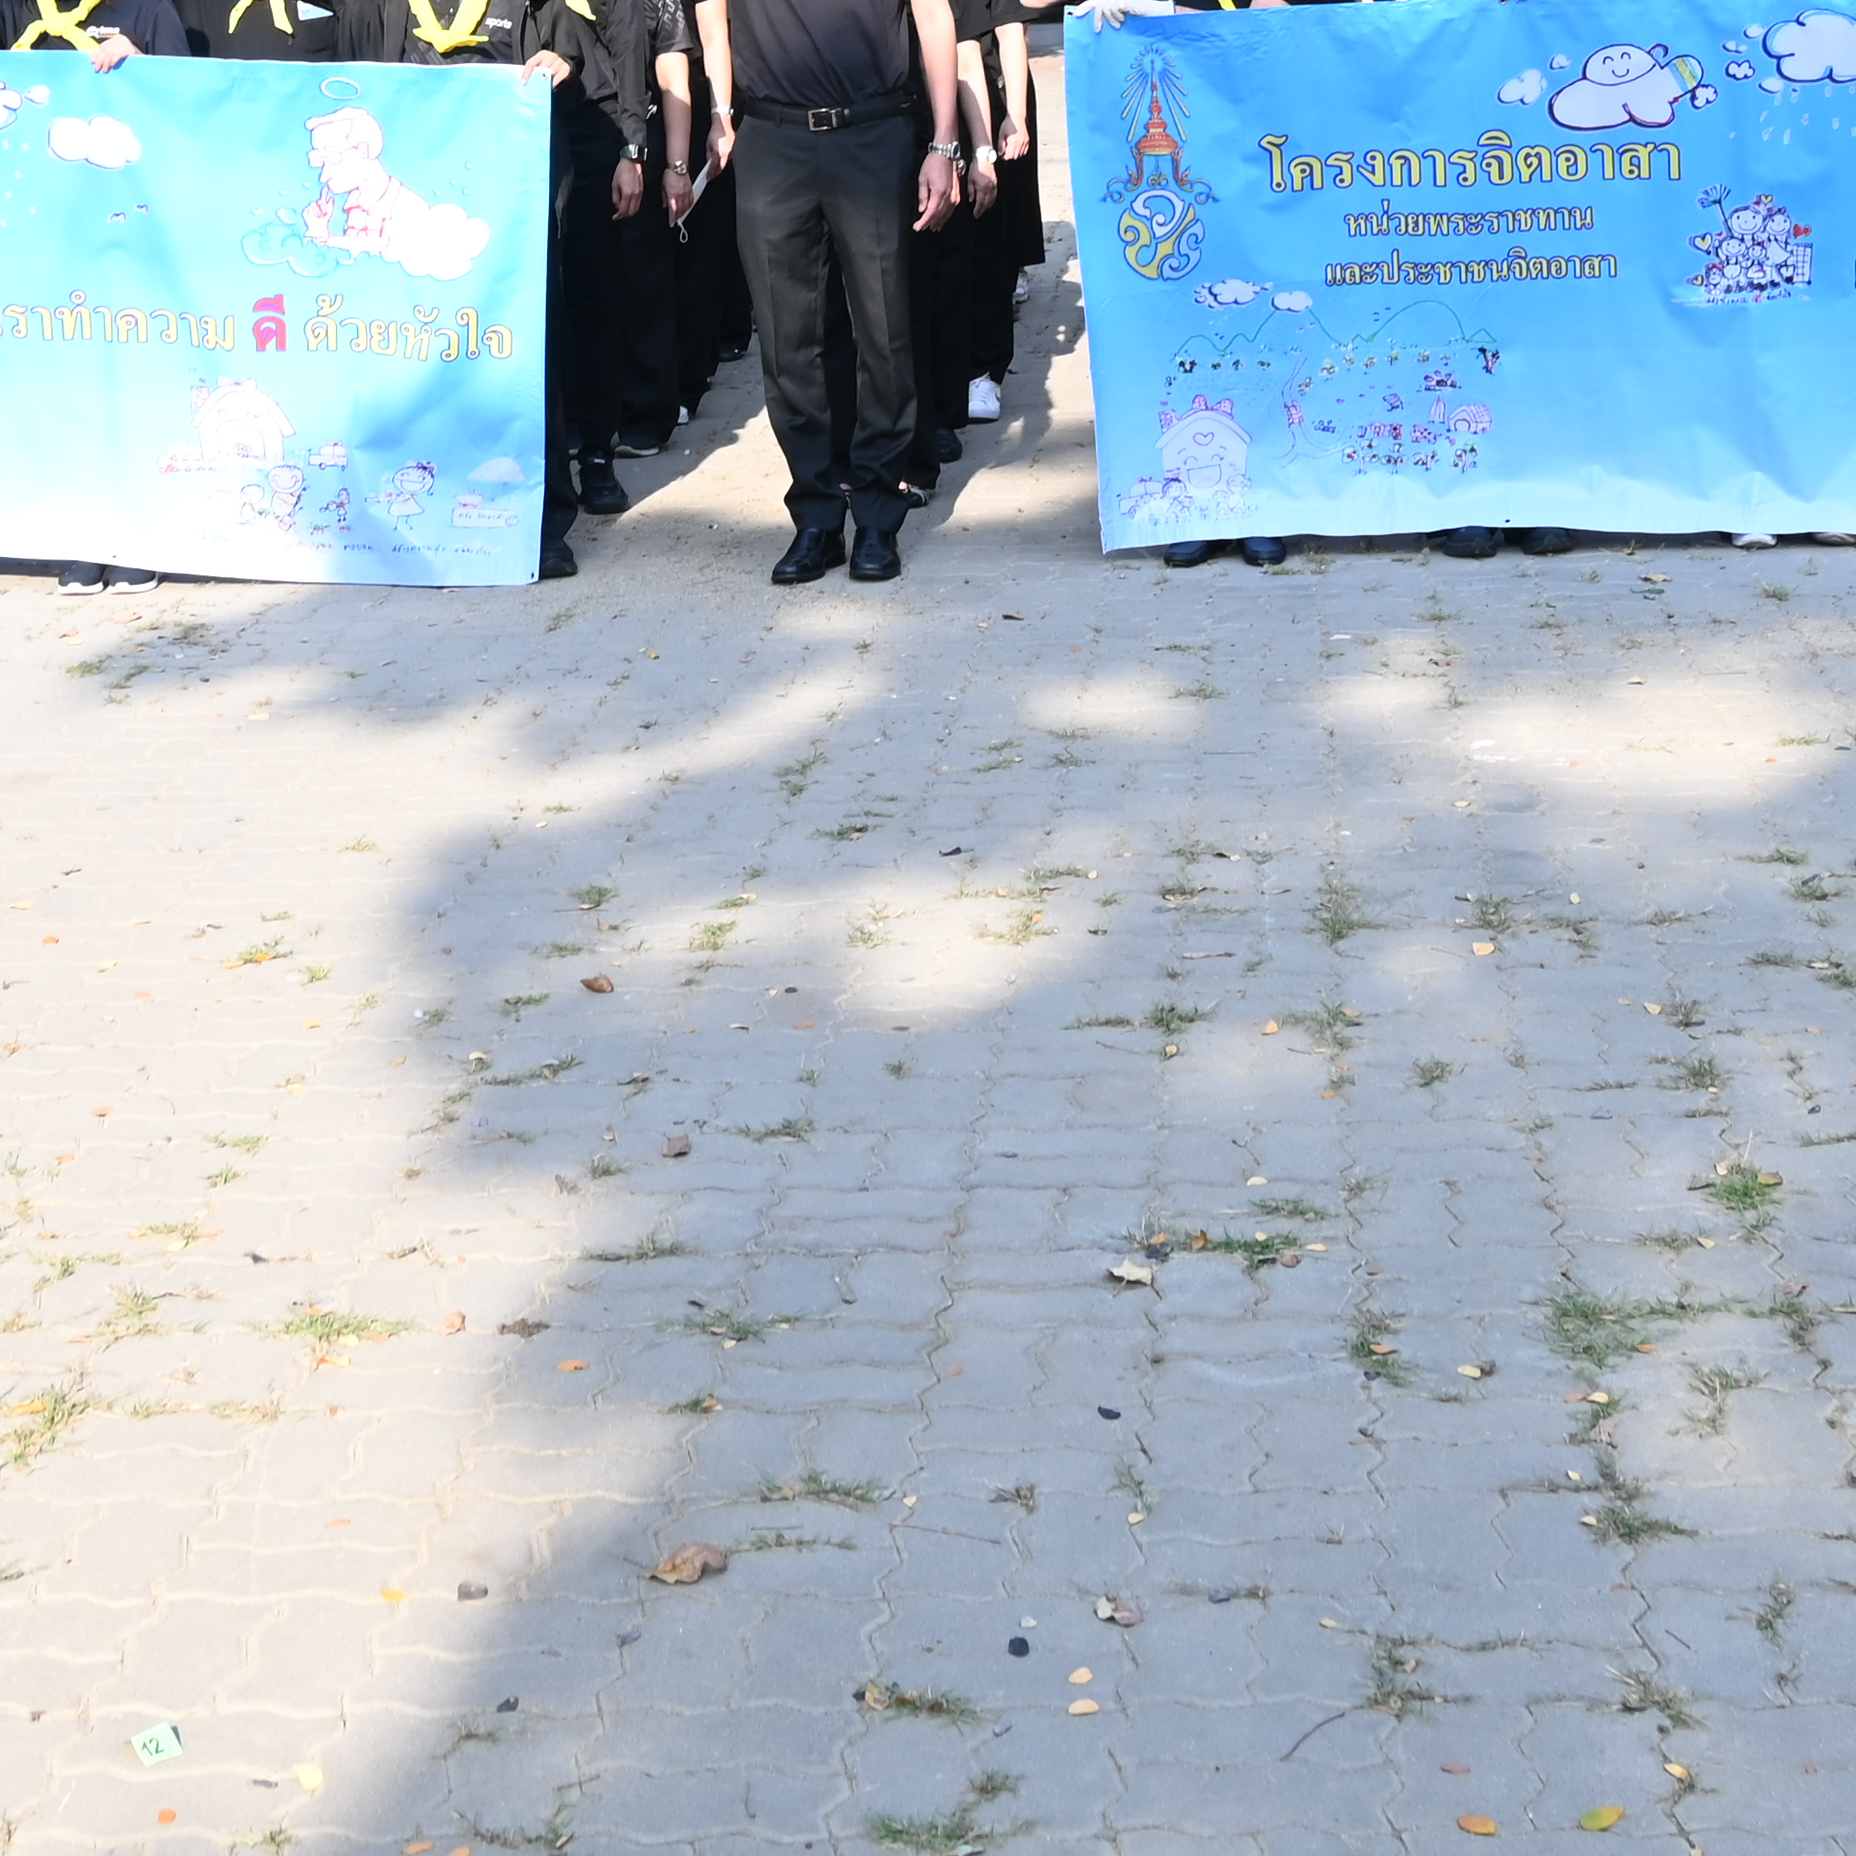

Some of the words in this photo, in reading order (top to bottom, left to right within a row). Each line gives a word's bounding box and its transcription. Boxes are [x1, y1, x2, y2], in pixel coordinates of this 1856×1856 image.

[1258, 129, 1682, 193] โครงการจิตอาสา
[1344, 198, 1594, 238] หน่วยพระราชทาน
[1324, 246, 1618, 287] และประชาชนจิตอาสา
[252, 293, 288, 352] ดี
[303, 293, 514, 362] ด้วยหัวใจ
[142, 1738, 164, 1757] 12
